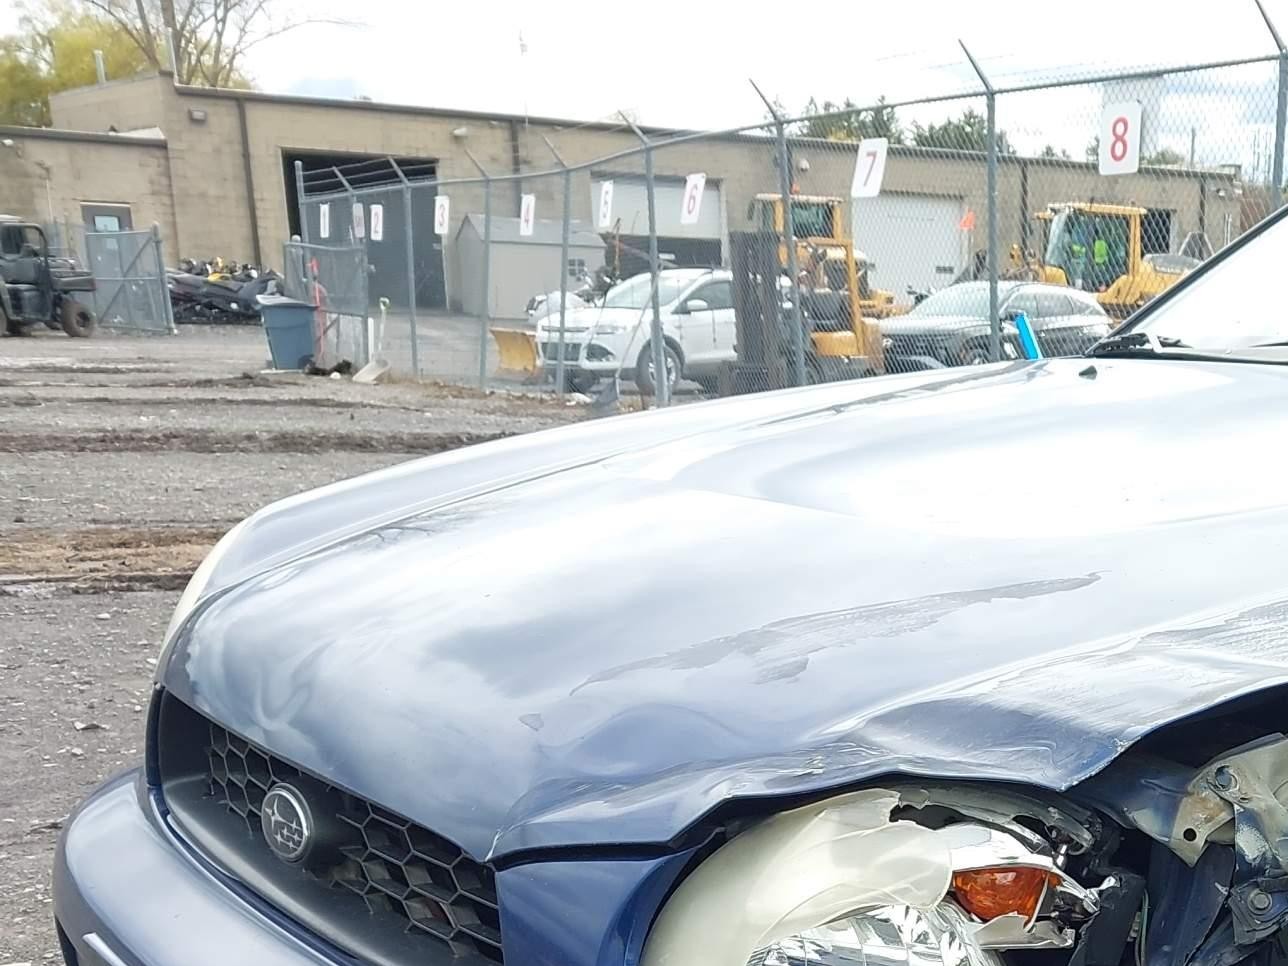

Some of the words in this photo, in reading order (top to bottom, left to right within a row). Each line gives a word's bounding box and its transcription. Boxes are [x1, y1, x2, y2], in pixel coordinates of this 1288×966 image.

[1110, 116, 1130, 162] 8
[862, 150, 878, 188] 7
[601, 190, 609, 218] 5
[686, 184, 698, 215] 6
[373, 212, 380, 234] 2
[437, 203, 446, 227] 3
[523, 203, 530, 225] 4
